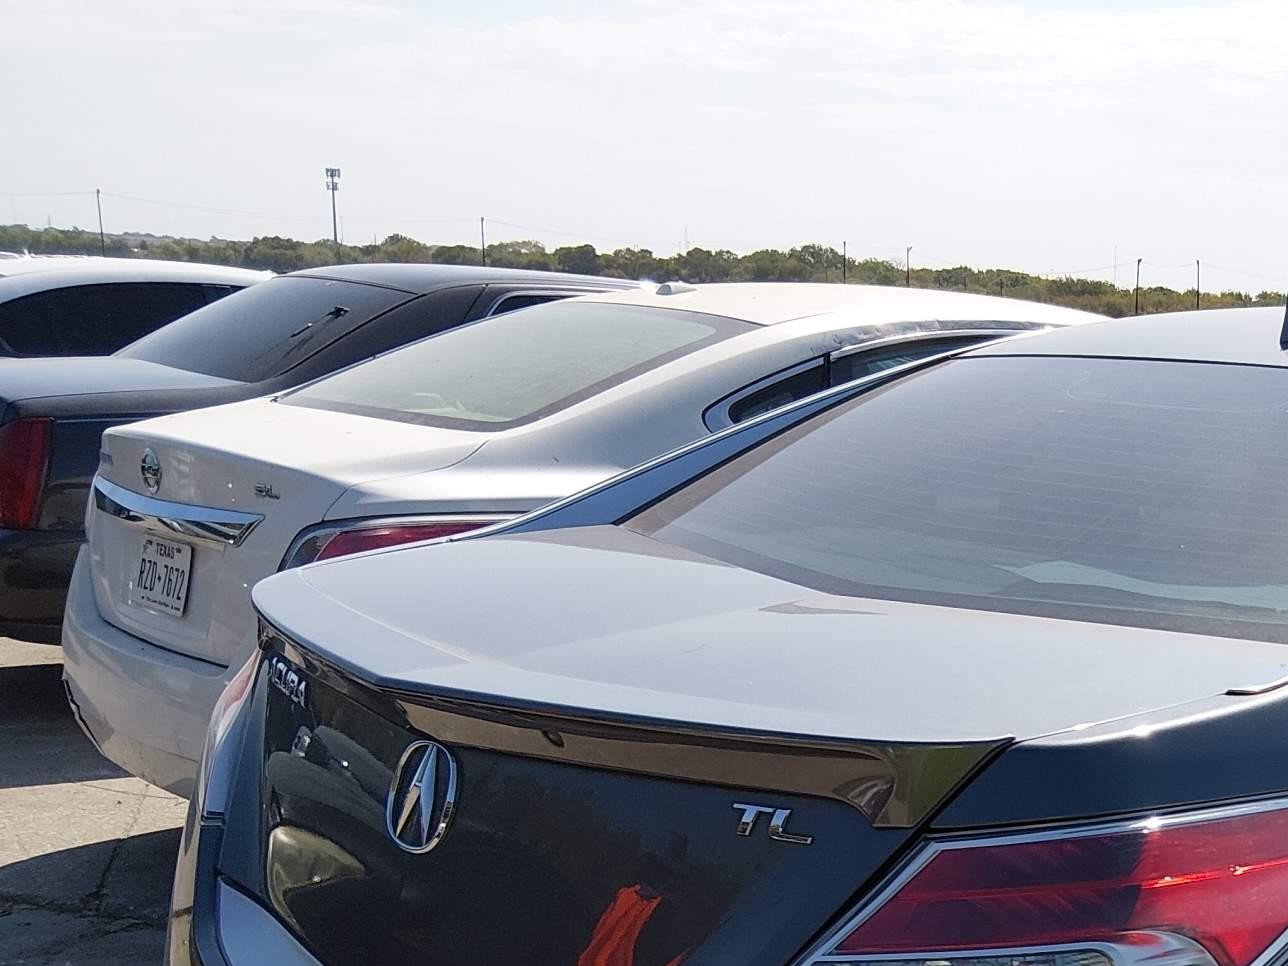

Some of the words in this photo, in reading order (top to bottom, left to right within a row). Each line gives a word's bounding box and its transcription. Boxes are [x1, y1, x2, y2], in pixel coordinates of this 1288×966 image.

[156, 542, 175, 559] TEXAS
[271, 656, 306, 708] ACURA
[732, 803, 813, 844] TL
